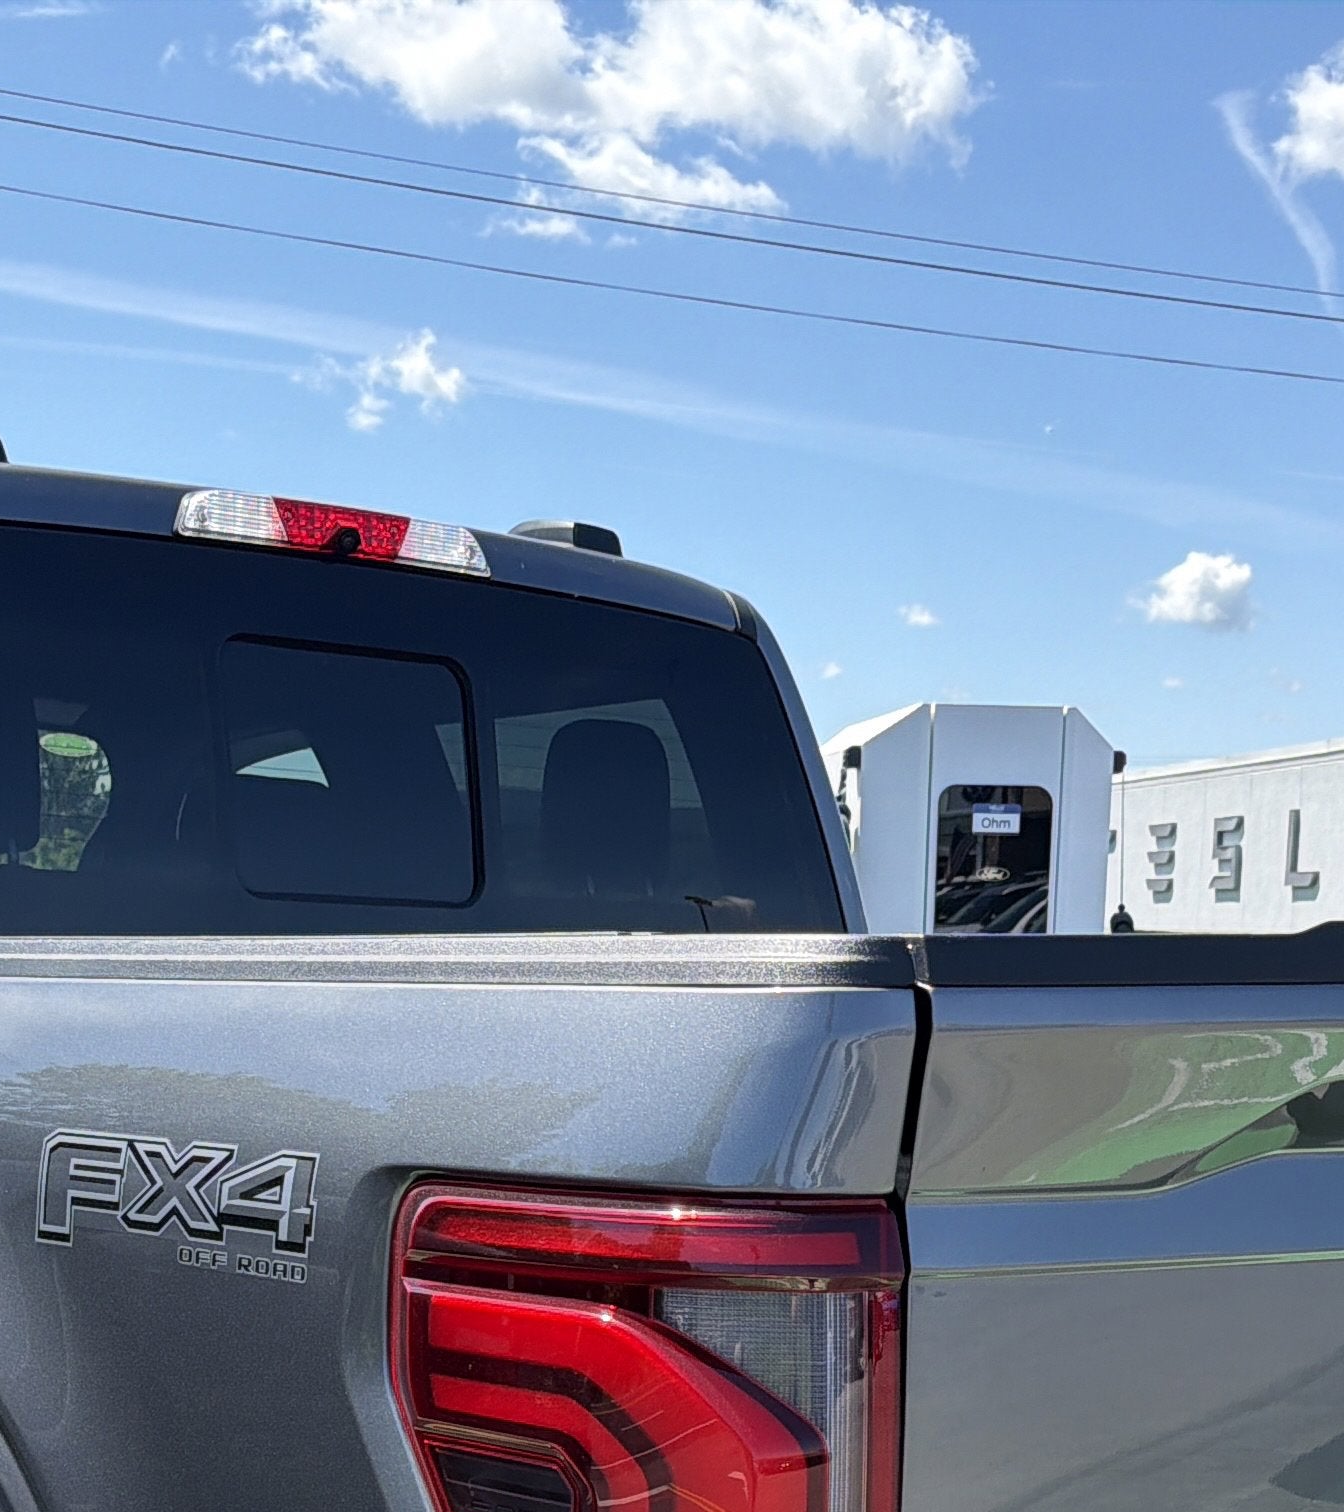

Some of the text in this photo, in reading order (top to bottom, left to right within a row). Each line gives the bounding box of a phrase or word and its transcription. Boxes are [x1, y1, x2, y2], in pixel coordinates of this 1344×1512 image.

[981, 816, 1011, 830] Ohm
[35, 1128, 320, 1258] FX4
[177, 1245, 307, 1284] OFF ROAD
